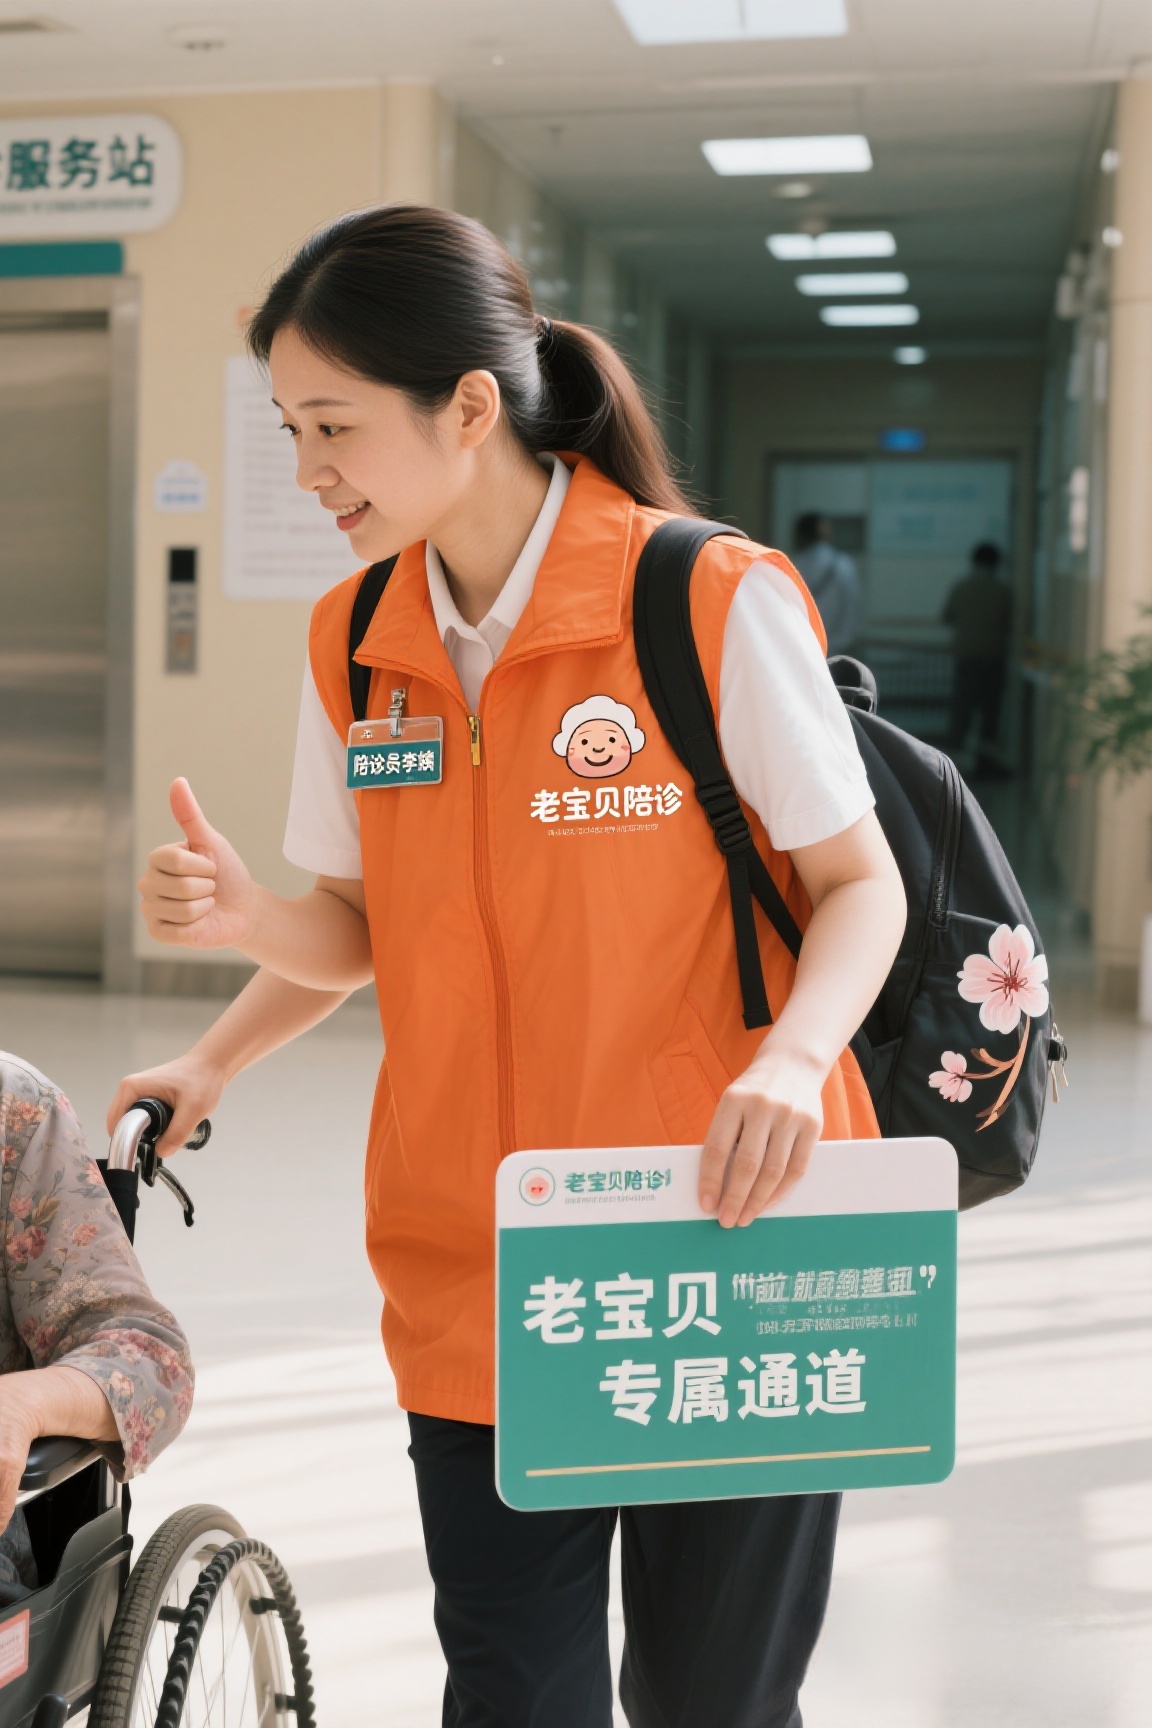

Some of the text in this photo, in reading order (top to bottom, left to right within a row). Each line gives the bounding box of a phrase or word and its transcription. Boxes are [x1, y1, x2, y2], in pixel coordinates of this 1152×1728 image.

[530, 782, 683, 823] 老宝贝陪诊
[522, 1271, 723, 1345] 老宝贝
[599, 1347, 868, 1427] 专属通道
